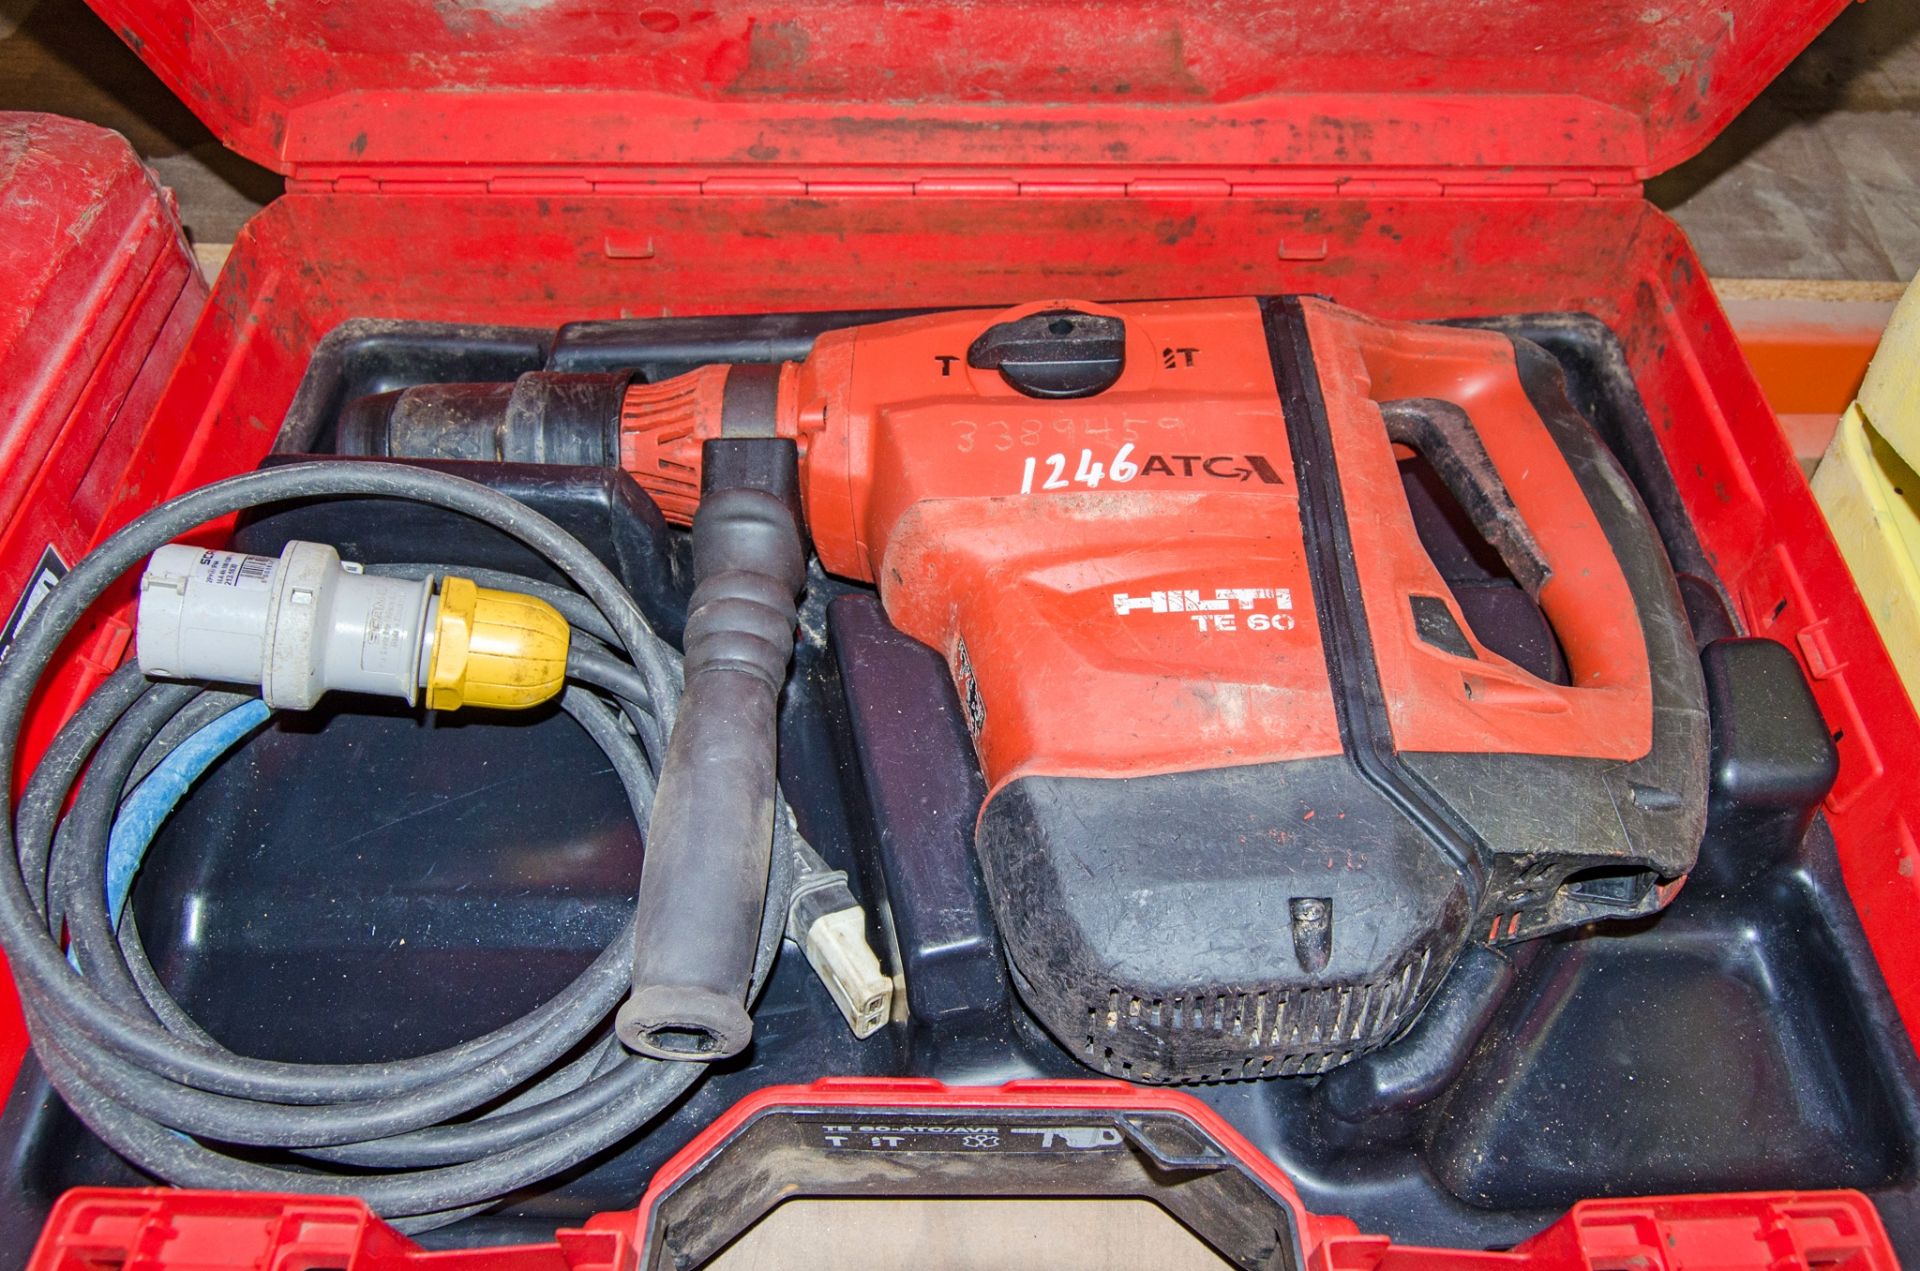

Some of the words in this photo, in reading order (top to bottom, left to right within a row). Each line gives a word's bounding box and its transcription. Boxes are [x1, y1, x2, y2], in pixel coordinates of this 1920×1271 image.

[1021, 443, 1139, 494] 1246
[1113, 588, 1293, 615] HILTI
[1191, 614, 1237, 632] TE
[1247, 614, 1295, 631] 60
[822, 1125, 852, 1133] TE
